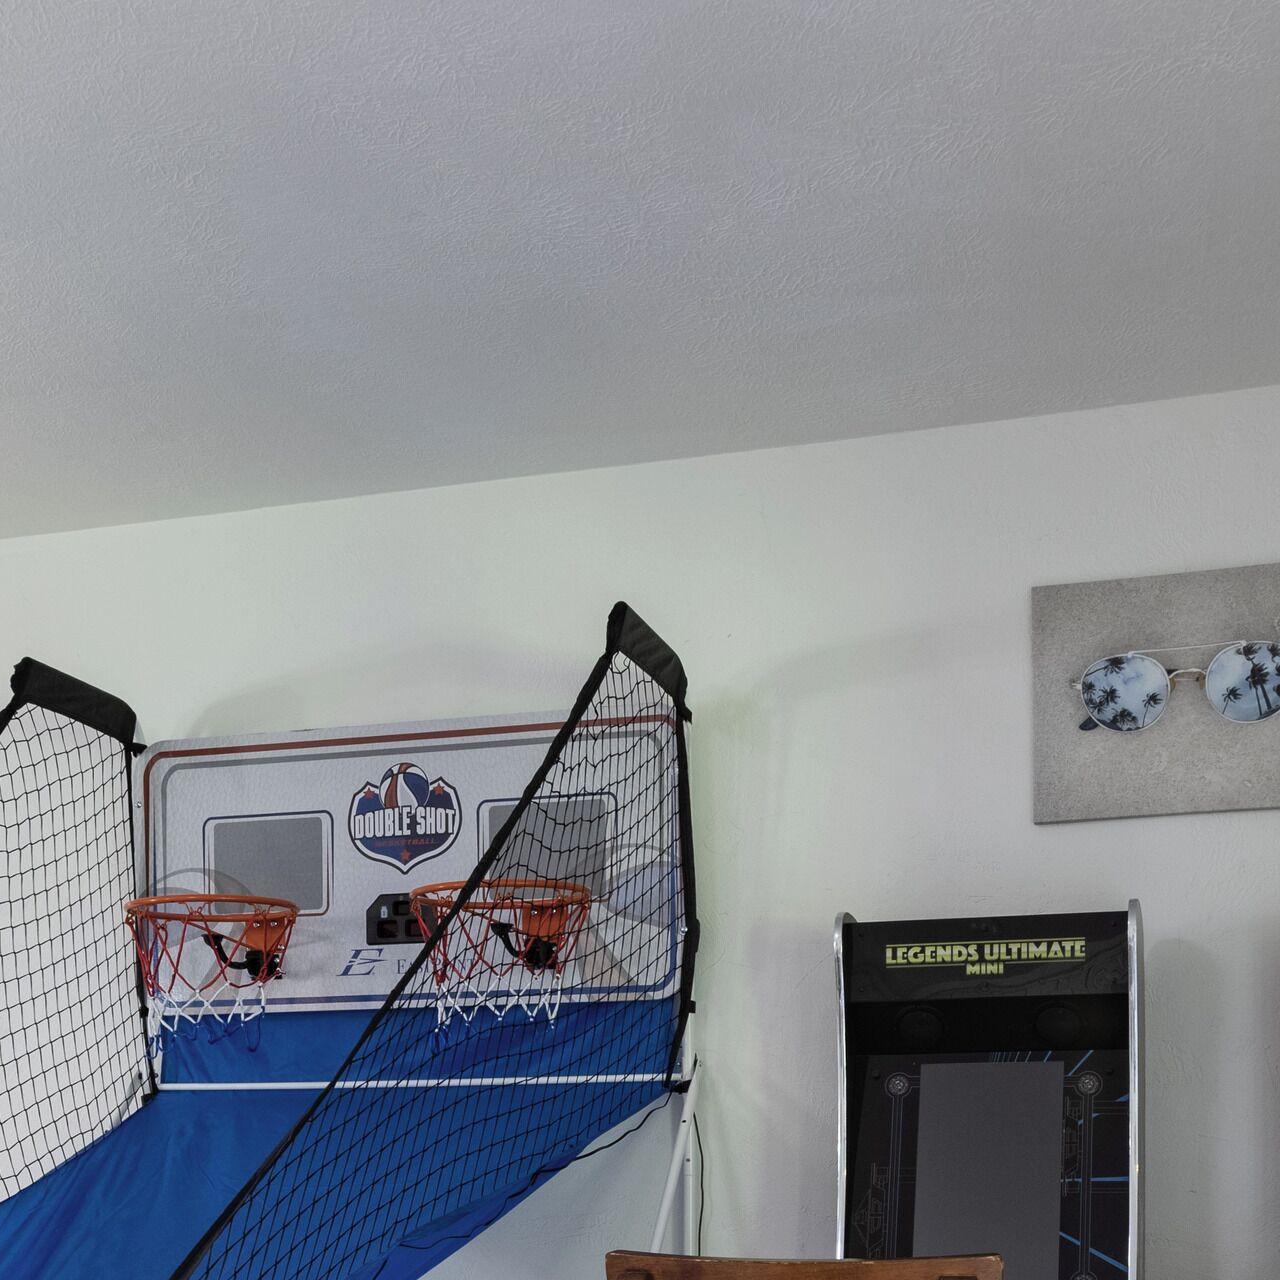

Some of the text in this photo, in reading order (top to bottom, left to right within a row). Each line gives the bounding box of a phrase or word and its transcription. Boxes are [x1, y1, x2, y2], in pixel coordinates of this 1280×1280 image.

[354, 804, 456, 839] DOUBLE SHOT
[886, 940, 1086, 965] LEGENDS ULTIMATE
[966, 962, 1004, 975] MINI
